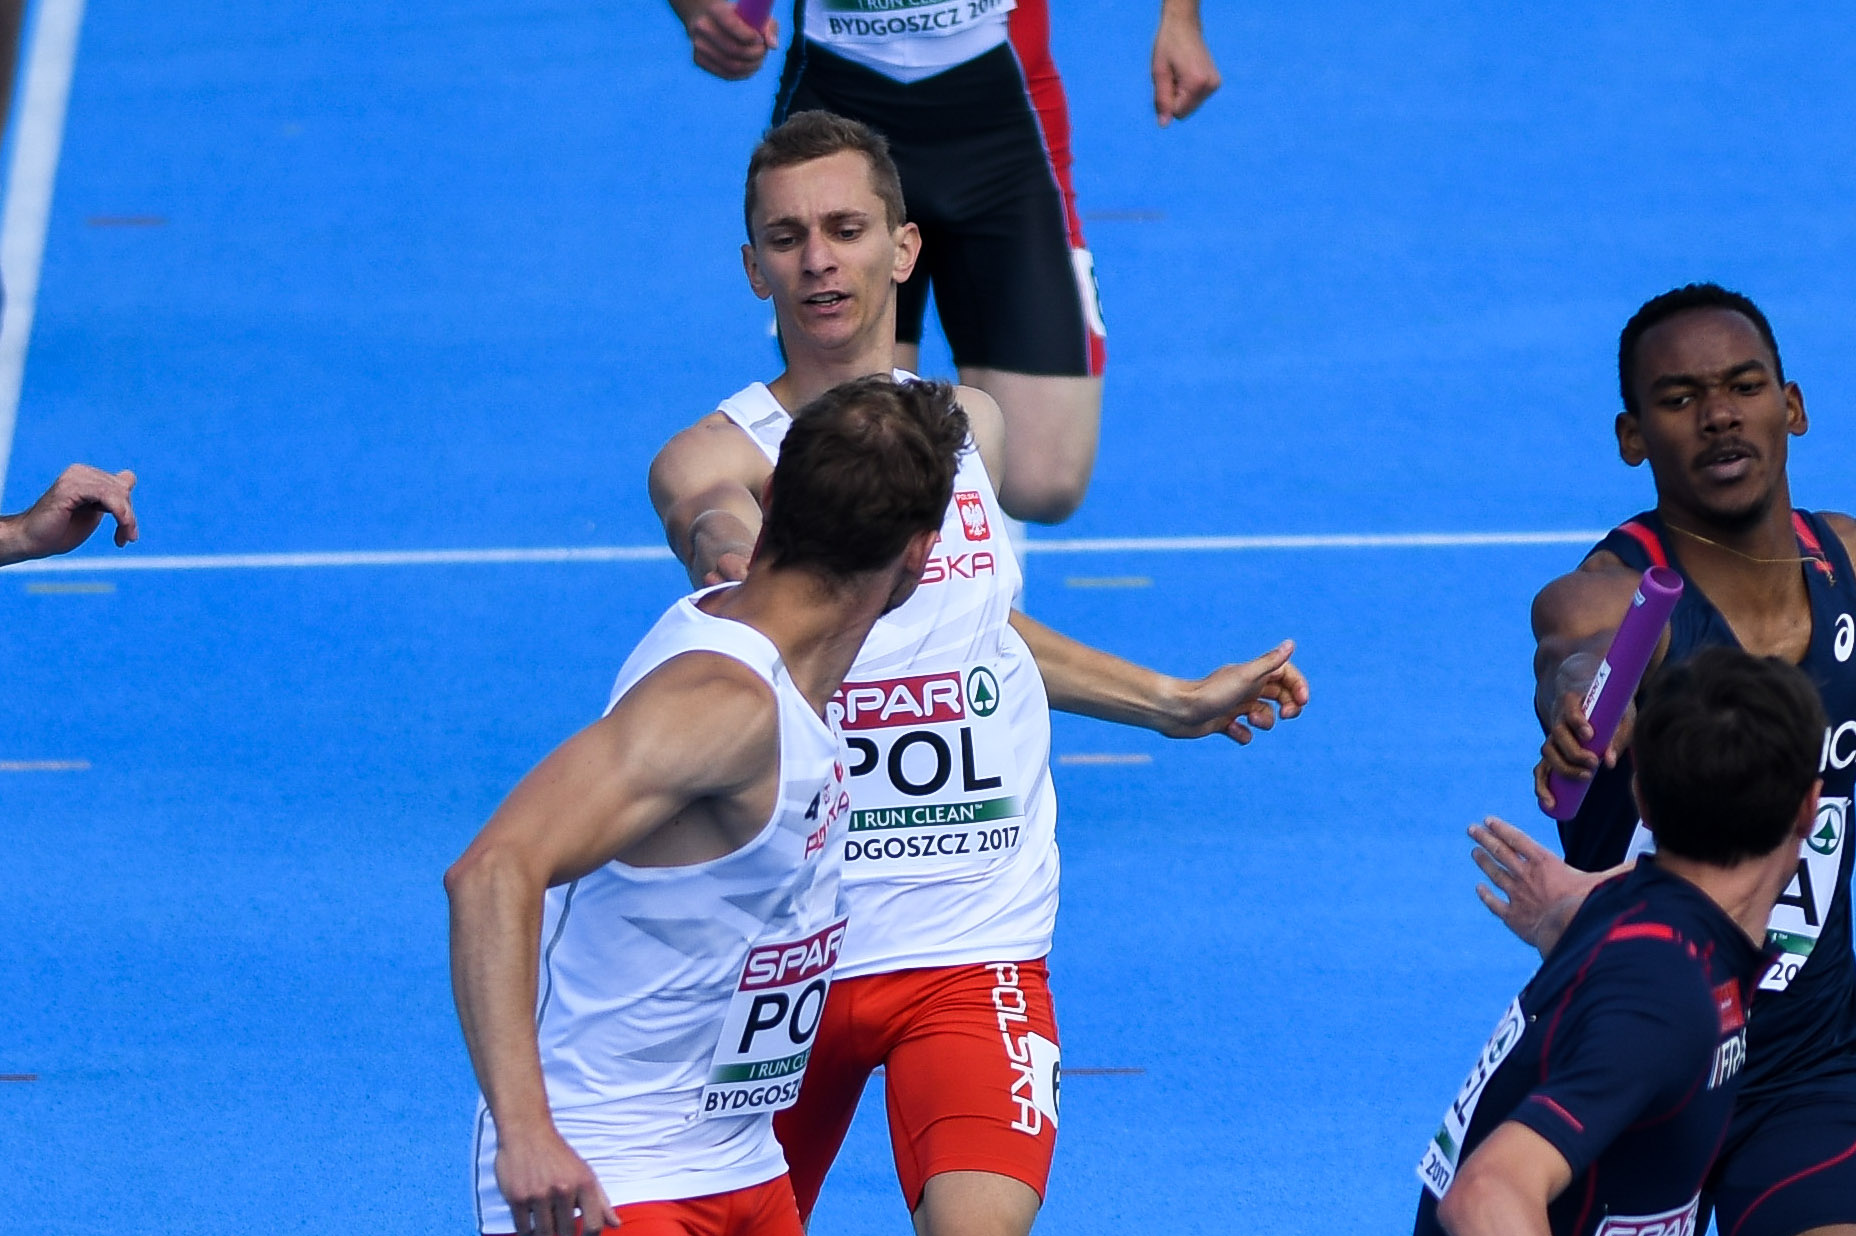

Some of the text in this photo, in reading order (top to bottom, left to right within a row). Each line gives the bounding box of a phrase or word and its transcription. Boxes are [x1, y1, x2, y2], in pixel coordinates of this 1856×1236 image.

[829, 8, 961, 36] BYDGOSZCZ
[919, 552, 994, 584] SKA
[853, 812, 859, 829] I
[865, 809, 906, 828] RUN
[844, 825, 1020, 861] DGOSZCZ 2017
[737, 979, 826, 1054] PO
[985, 963, 1042, 1136] POLSKA
[749, 1064, 756, 1079] I
[758, 1058, 791, 1077] RUN
[705, 1079, 801, 1112] BYDGOSZ
[1425, 1153, 1450, 1191] 2017
